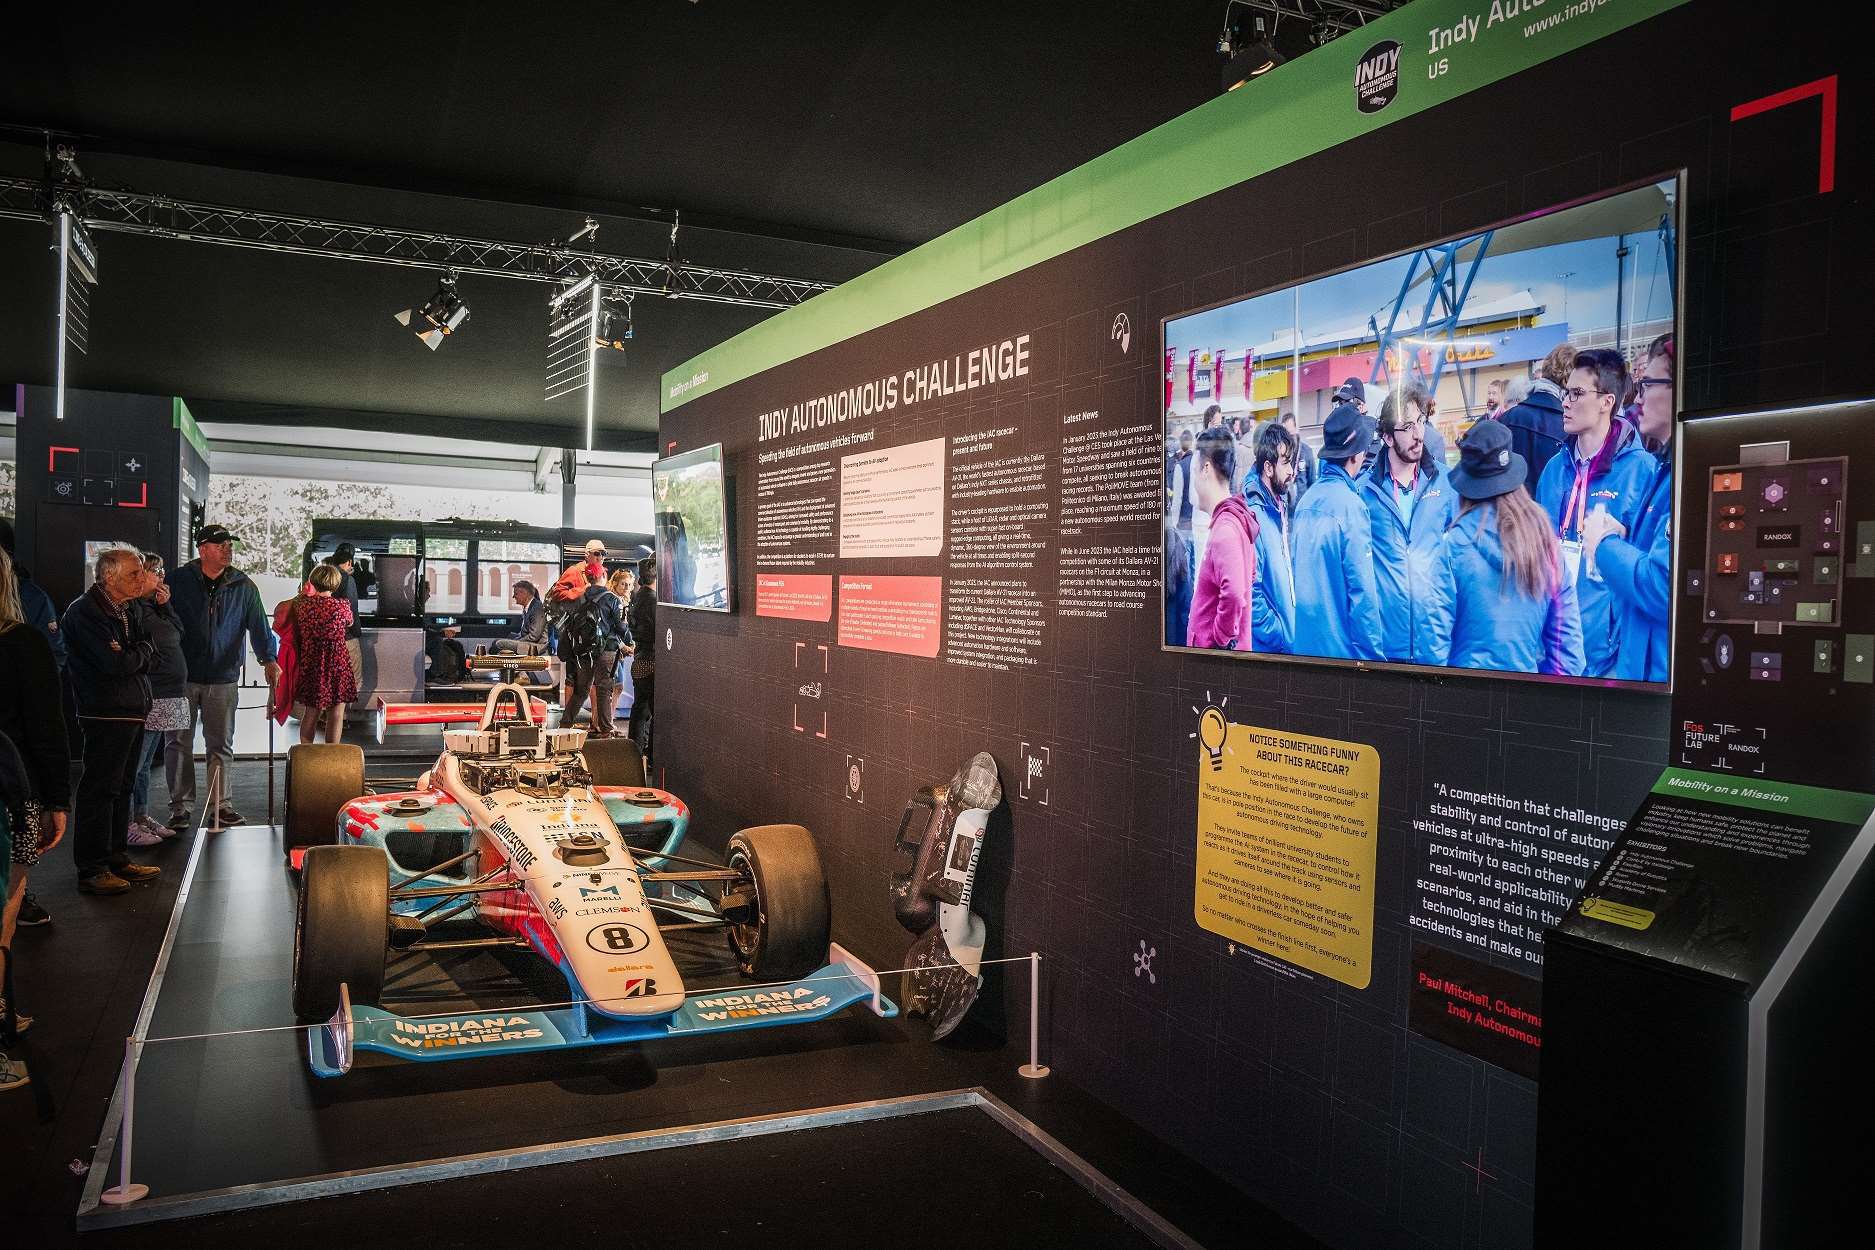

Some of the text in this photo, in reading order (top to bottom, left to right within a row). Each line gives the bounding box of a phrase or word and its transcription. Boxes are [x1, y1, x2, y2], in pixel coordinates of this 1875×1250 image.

[1428, 14, 1480, 54] Indy
[1354, 45, 1402, 88] INDY
[1428, 58, 1448, 80] US
[1361, 79, 1394, 98] CHALLENGE
[758, 335, 1028, 441] INDY AUTONOMOUS CHALLENGE
[1064, 411, 1098, 423] Latest News
[759, 451, 777, 464] Speeding
[786, 446, 795, 457] field
[796, 444, 800, 455] of
[801, 441, 829, 454] autonomous
[830, 434, 850, 448] vehicles
[851, 428, 873, 443] forward
[1764, 532, 1792, 542] RANDOX
[1250, 734, 1359, 761] NOTICE SOMETHING FUNNY
[1686, 732, 1720, 743] FUTURE
[1686, 740, 1702, 748] LAB
[1728, 744, 1760, 753] RANDOX
[1256, 750, 1349, 775] ABOUT THIS RACECAR?
[1668, 777, 1712, 792] Mobility
[1740, 788, 1788, 802] Mission
[1434, 783, 1626, 831] "A competition that challenges
[1430, 803, 1476, 824] stability
[1480, 814, 1501, 827] and
[1505, 820, 1549, 837] control
[1554, 828, 1567, 840] of
[1413, 820, 1457, 837] vehicles
[1460, 829, 1472, 841] at
[1476, 832, 1537, 857] ultra-high
[1541, 849, 1588, 867] speeds
[1626, 840, 1668, 852] EXHIBITORS
[1430, 843, 1483, 866] proximity
[1486, 854, 1498, 867] to
[1502, 861, 1530, 876] each
[1535, 867, 1570, 884] other
[1430, 862, 1490, 886] real-world
[1494, 879, 1572, 910] applicability
[549, 898, 568, 920] aws
[1416, 879, 1474, 904] scenarios,
[1478, 896, 1500, 909] and
[1504, 901, 1522, 916] aid
[1526, 905, 1537, 920] in
[1422, 897, 1494, 928] technologies
[1498, 918, 1523, 937] that
[602, 928, 634, 950] 8
[1409, 915, 1462, 938] accidents
[1466, 932, 1486, 946] and
[1490, 940, 1521, 957] make
[695, 988, 814, 1008] INDIANA
[1419, 972, 1441, 990] Paul
[1444, 981, 1491, 1010] Mitchell,
[698, 996, 831, 1020] WINNERS
[1448, 1001, 1472, 1022] Indy
[395, 1016, 530, 1034] INDIANA
[424, 1027, 502, 1039] FOR THE
[390, 1028, 544, 1048] WINNERS
